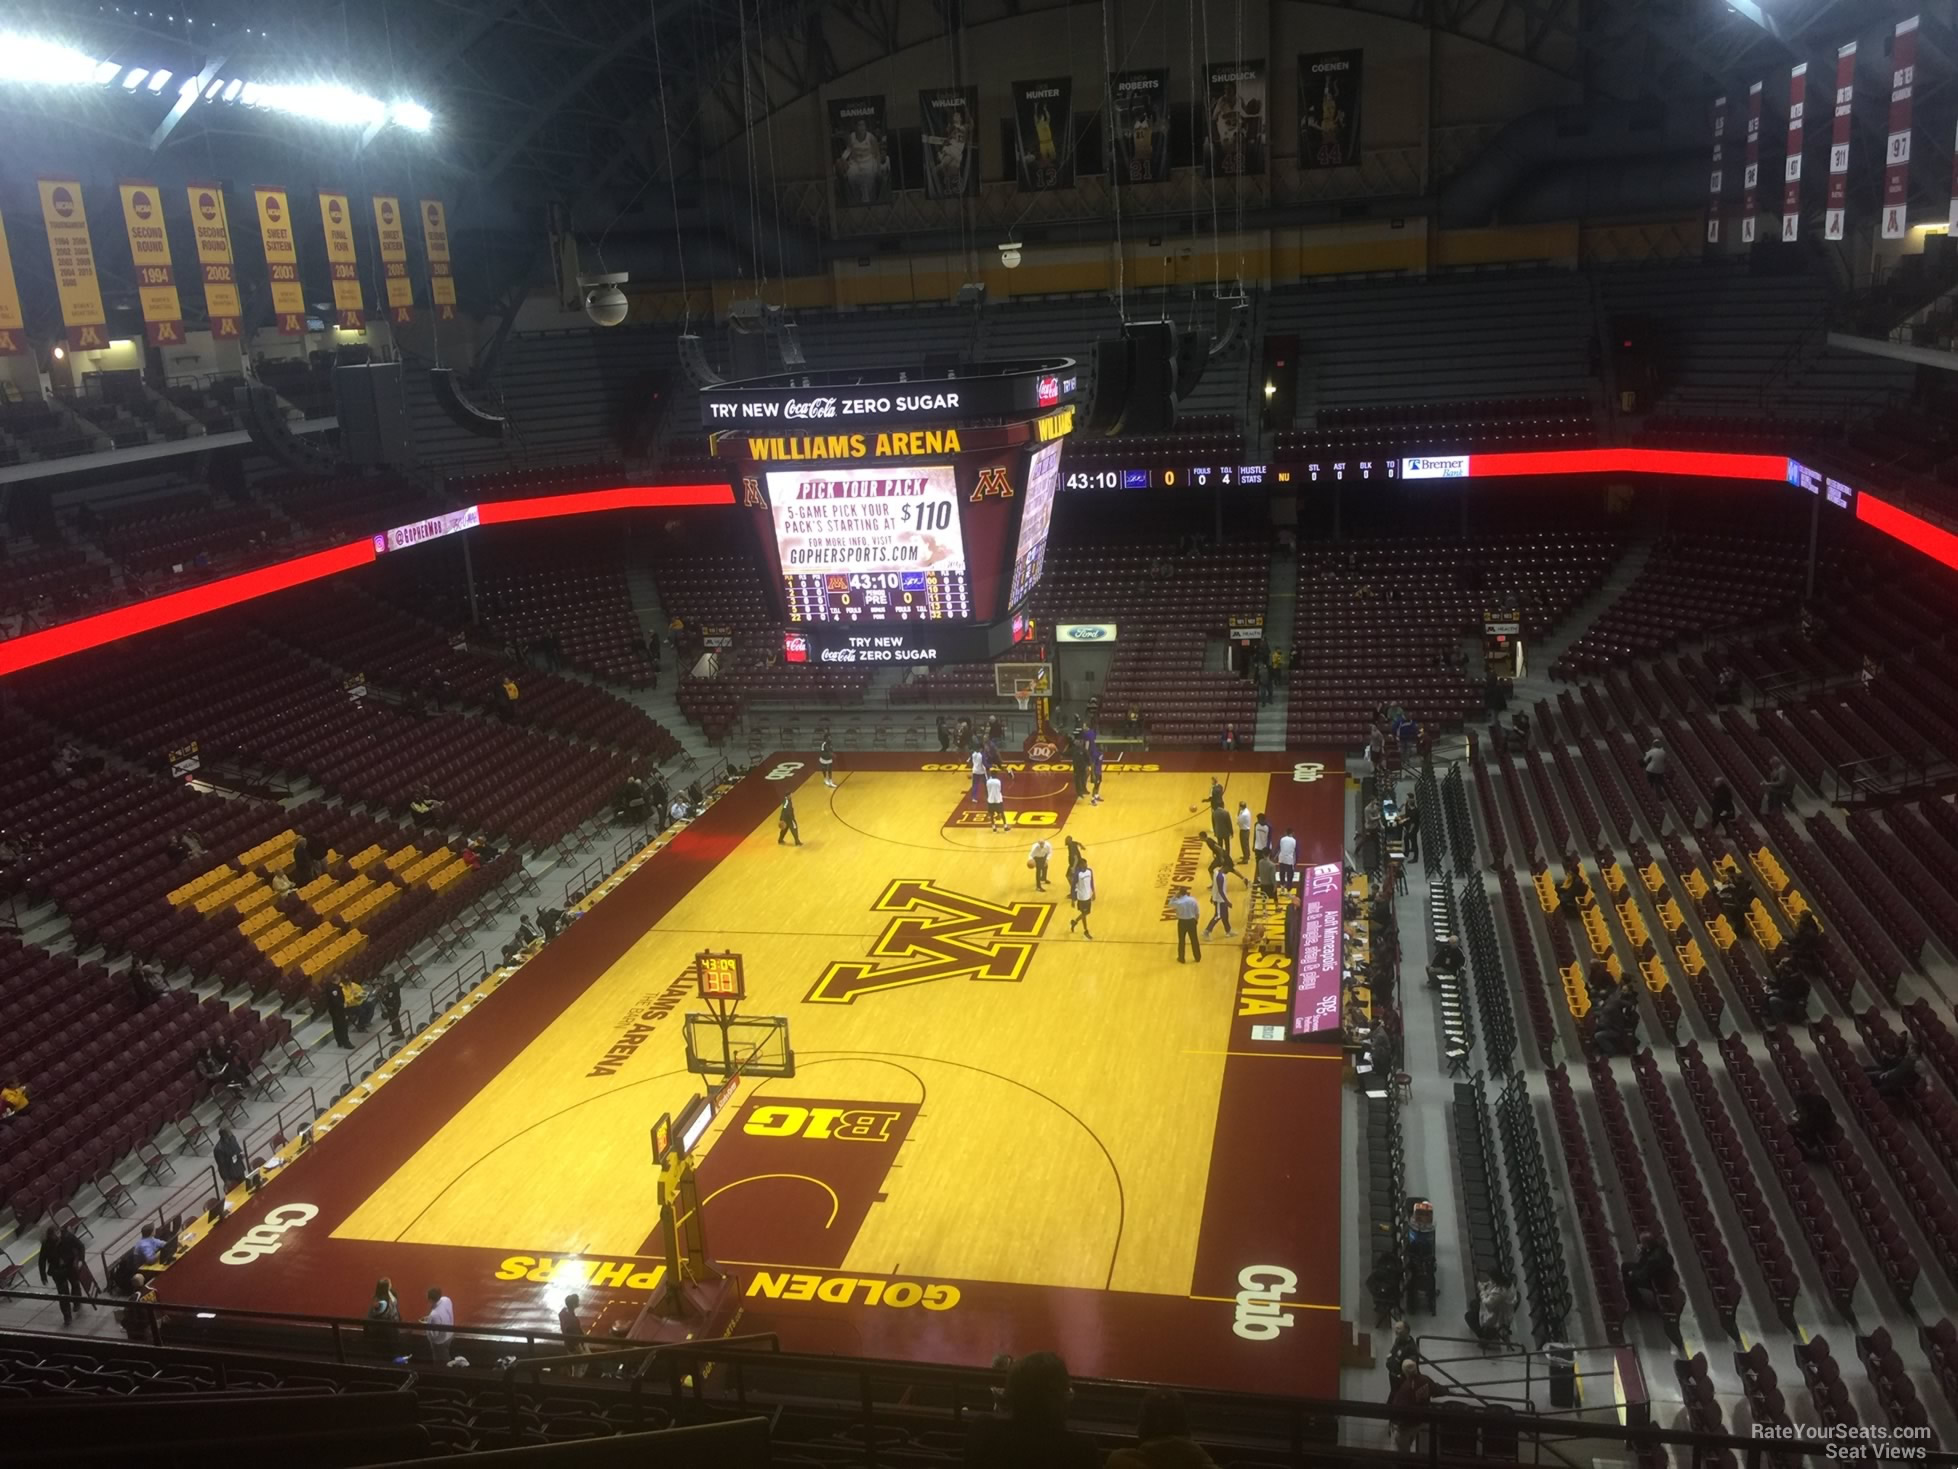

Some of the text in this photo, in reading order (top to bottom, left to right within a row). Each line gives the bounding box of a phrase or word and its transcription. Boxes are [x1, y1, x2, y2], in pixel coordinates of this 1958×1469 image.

[1312, 61, 1349, 72] COENEN
[1212, 70, 1256, 83] SHUDLICK
[1118, 80, 1159, 91] ROBERTS
[1025, 88, 1060, 100] HUNTER
[931, 97, 966, 108] WHALEN
[840, 107, 875, 118] BANHAM
[1318, 144, 1342, 165] 44
[1130, 160, 1152, 180] 21
[1036, 168, 1057, 188] 13
[132, 226, 162, 239] SECOND
[267, 228, 288, 239] SWEET
[332, 230, 348, 240] FINAL
[136, 240, 164, 253] ROUND
[202, 240, 226, 252] ROUND
[266, 240, 292, 252] SIXTEEN
[334, 242, 349, 252] FOUR
[142, 268, 168, 284] 1994
[206, 266, 231, 280] 2002
[272, 265, 294, 280] 2003
[710, 393, 960, 420] TRY NEW Coca-Cola ZERO SUGAR
[748, 430, 960, 460] WILLIAMS ARENA
[1240, 466, 1267, 474] HUSTLE
[1422, 459, 1464, 470] Bremer
[1164, 471, 1174, 486] 0
[1198, 474, 1230, 485] 0 4
[1241, 475, 1262, 484] STATS
[1278, 472, 1290, 482] NU
[1312, 469, 1394, 480] 0 0 0 0
[1442, 469, 1464, 478] Bank
[1066, 471, 1117, 490] 43:10
[802, 478, 924, 499] PICK YOUR PACK
[788, 505, 827, 520] 5-GAME
[832, 504, 858, 518] PICK
[861, 503, 889, 516] YOUR
[785, 518, 896, 534] PACK'S STARTING AT
[808, 537, 822, 548] FOR
[826, 536, 846, 547] MORE
[872, 536, 892, 546] VISIT
[790, 546, 918, 564] GOPHERSPORTS.COM
[850, 572, 898, 590] 43:10
[842, 592, 912, 605] 0 PRE 0
[791, 614, 802, 622] 22
[1074, 628, 1099, 639] Ford
[849, 636, 904, 648] TRY NEW
[860, 650, 892, 660] ZERO
[894, 648, 936, 660] SUGAR
[1033, 746, 1050, 757] DQ
[765, 762, 805, 780] Cub
[920, 763, 1160, 772] GOLN GOERS
[1293, 762, 1325, 782] Cub
[1172, 836, 1203, 882] WILLIAMS
[1320, 911, 1338, 972] Aloft Minneapolis
[702, 959, 736, 970] 43:09
[708, 972, 732, 992] 30
[614, 992, 660, 1030] THE BARN
[585, 961, 698, 1078] ILLIAMS ARENA
[220, 1202, 320, 1266] Cub
[746, 1270, 961, 1312] GOLDEN
[1232, 1264, 1298, 1341] Cub
